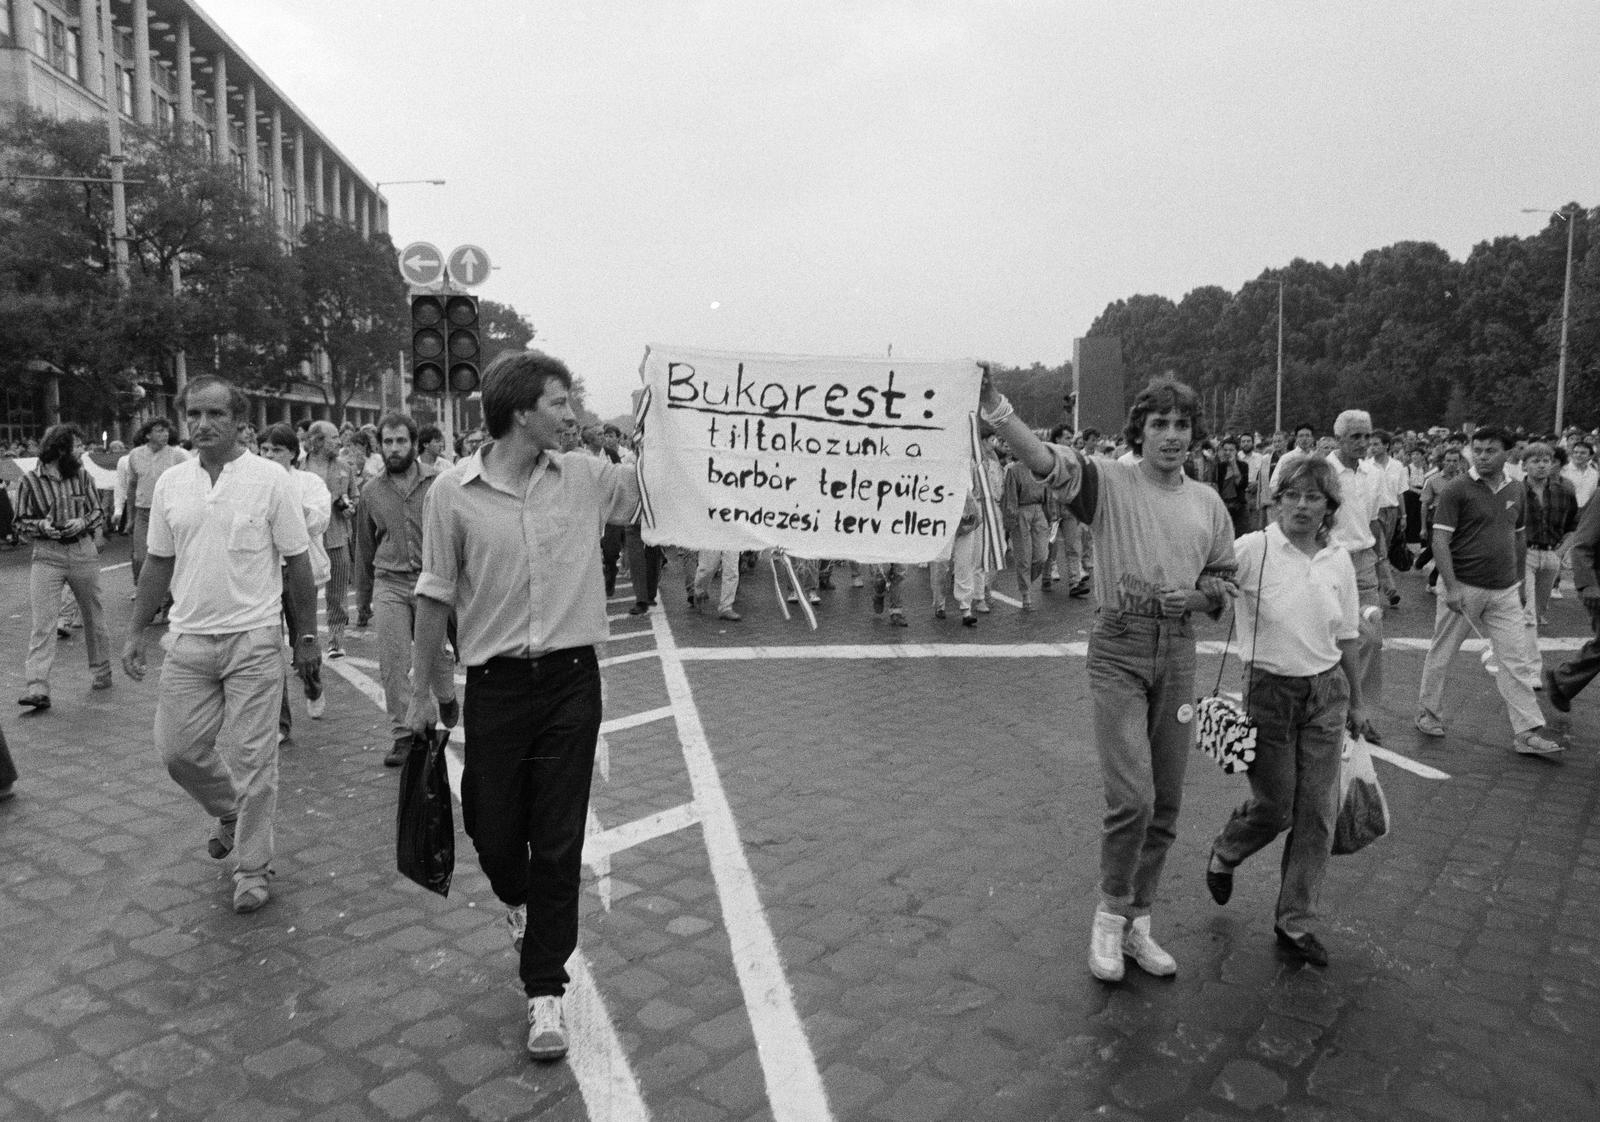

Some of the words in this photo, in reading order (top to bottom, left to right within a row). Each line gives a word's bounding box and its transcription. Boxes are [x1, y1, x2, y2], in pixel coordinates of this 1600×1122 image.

[708, 417, 890, 456] tiltakozunk
[905, 443, 921, 457] a
[819, 467, 954, 511] település-
[708, 503, 820, 532] rendezési
[835, 510, 881, 534] terv
